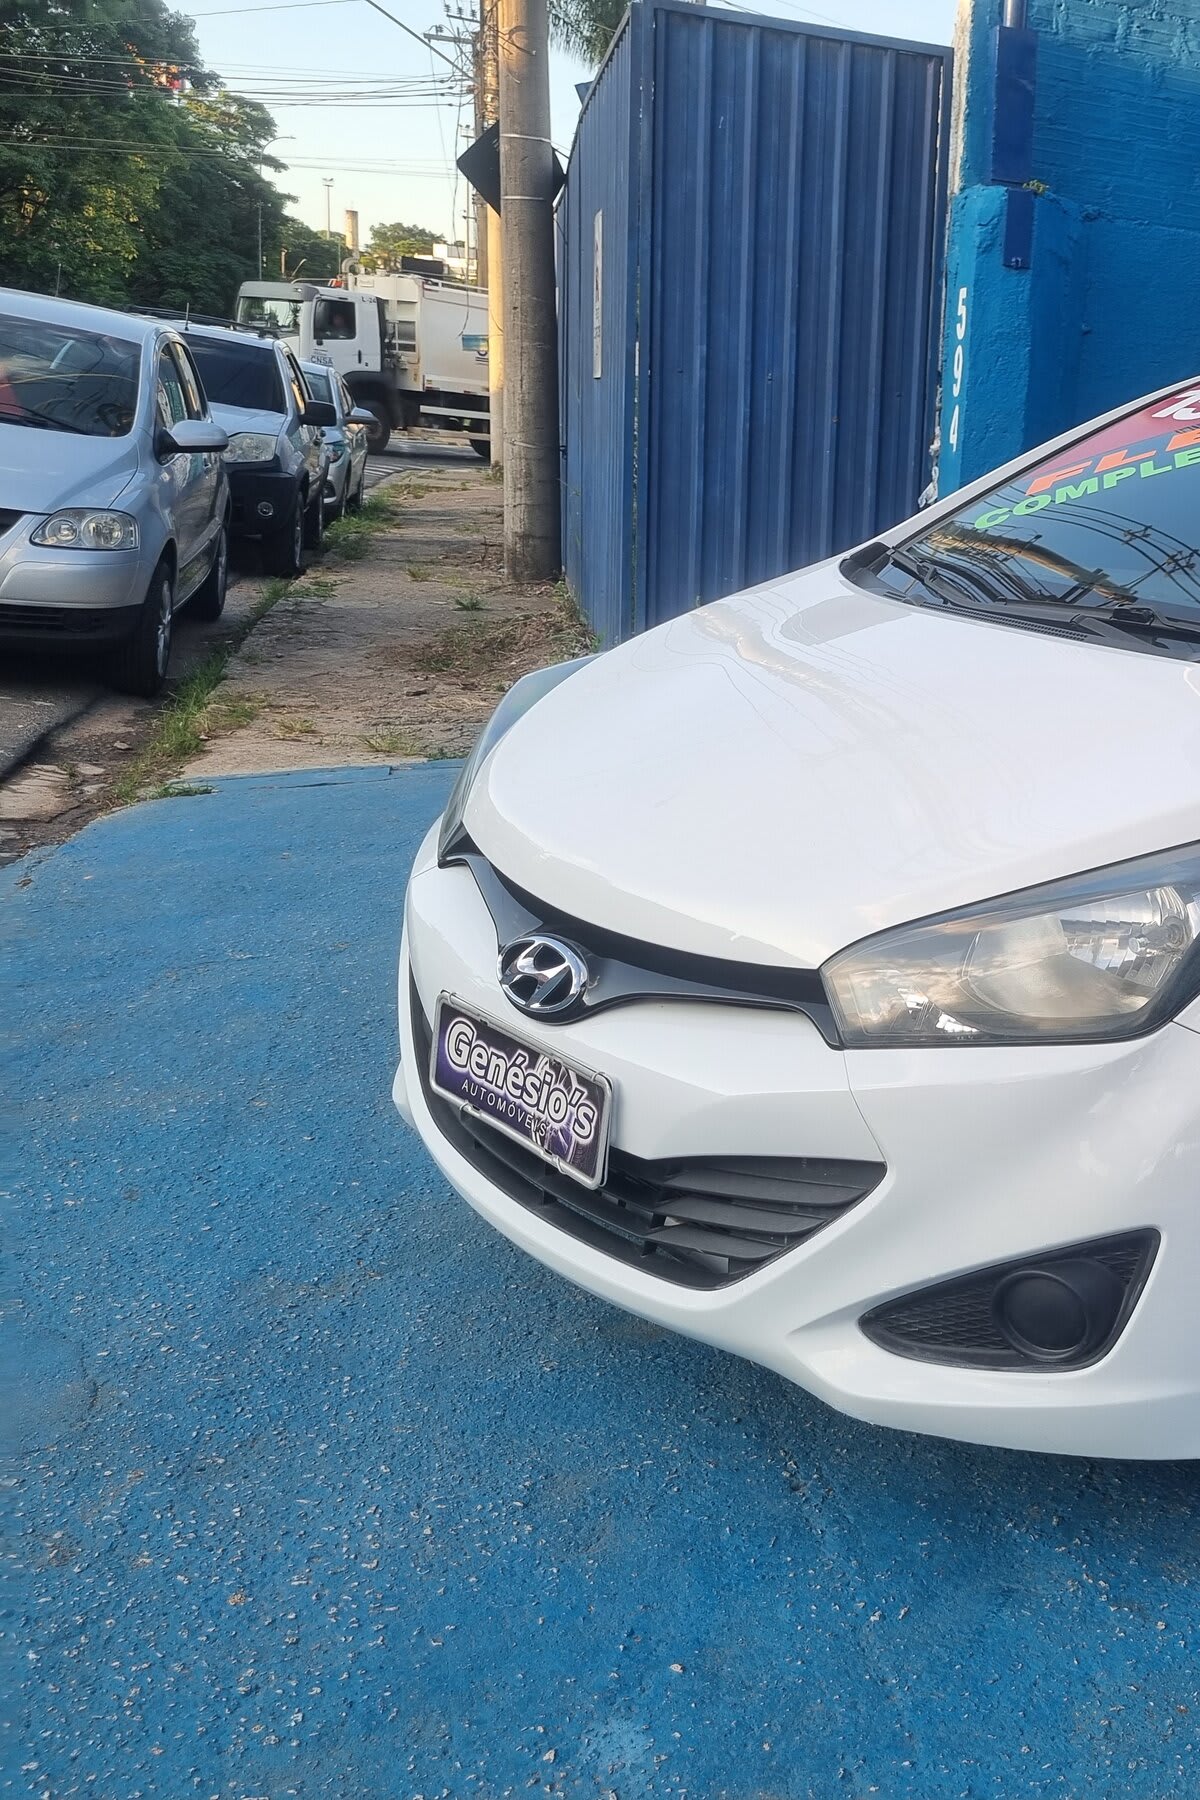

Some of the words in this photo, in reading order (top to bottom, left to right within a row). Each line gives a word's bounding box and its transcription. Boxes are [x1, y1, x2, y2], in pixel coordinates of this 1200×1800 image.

[949, 286, 968, 453] 594
[446, 1019, 597, 1141] Genésio's
[460, 1078, 547, 1138] AUTOMÓVEIS
